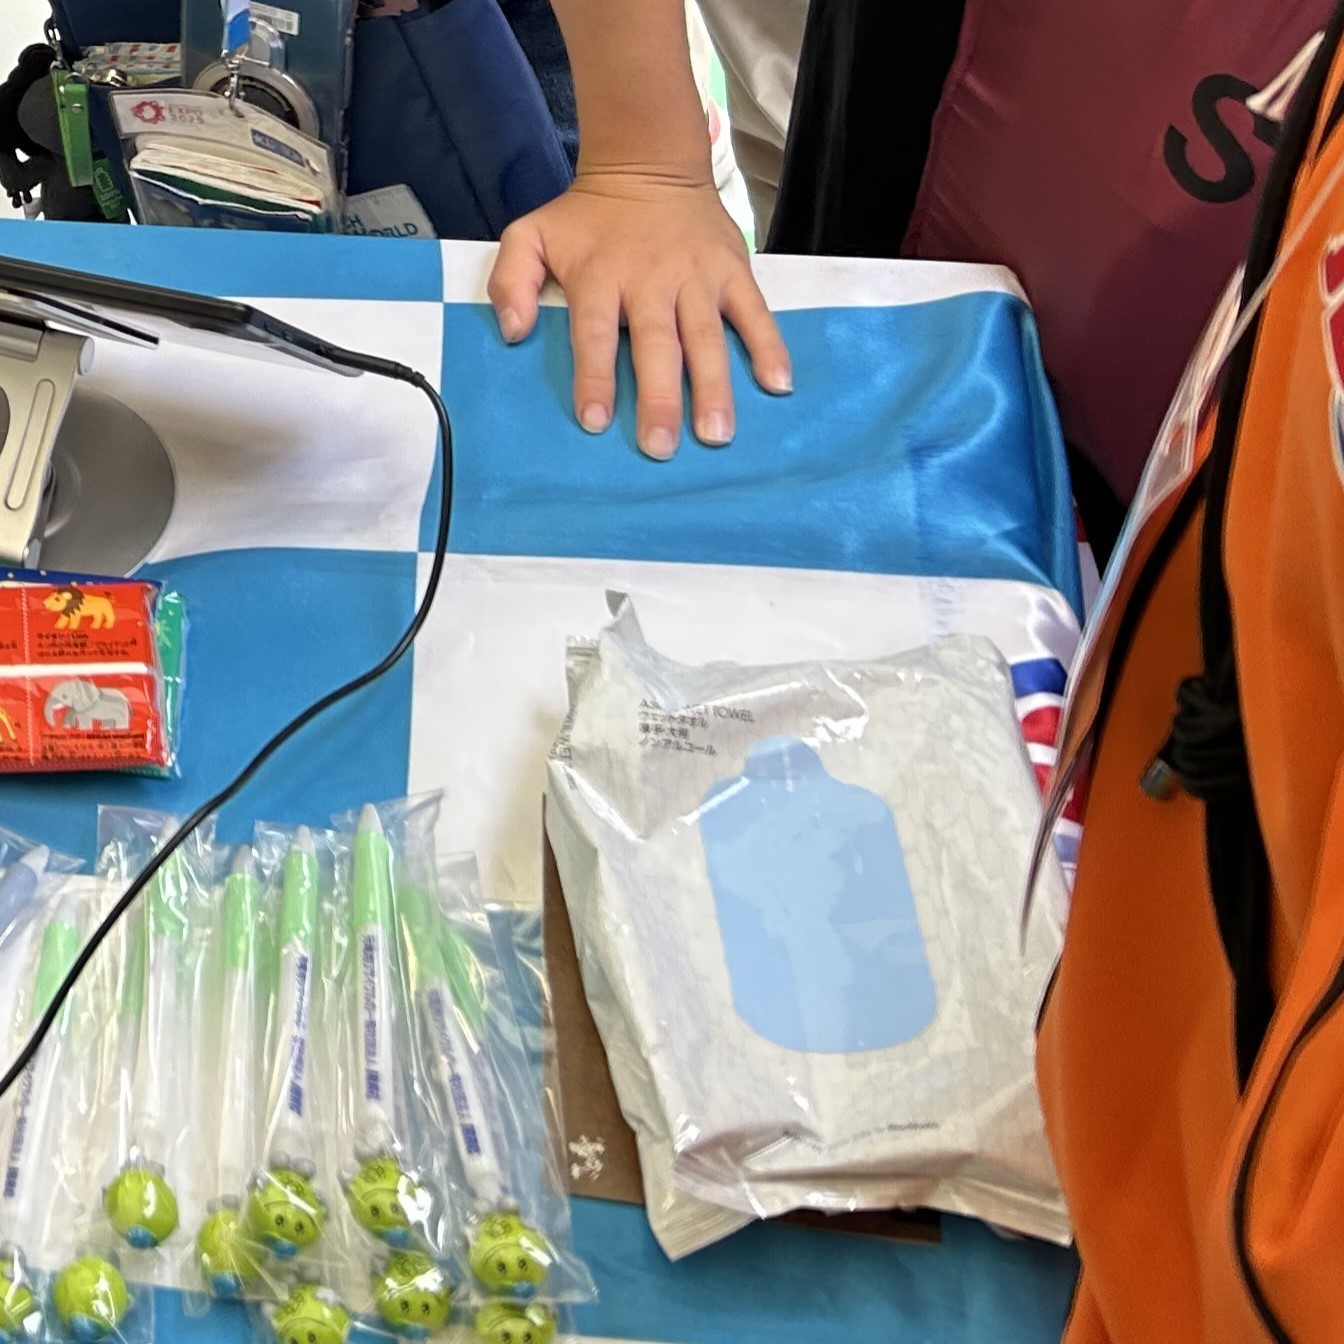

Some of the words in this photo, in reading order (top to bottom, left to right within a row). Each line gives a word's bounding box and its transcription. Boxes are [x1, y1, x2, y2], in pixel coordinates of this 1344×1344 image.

[1163, 73, 1282, 203] S
[712, 706, 756, 723] TOWEL
[638, 737, 718, 757] ノンアルコール
